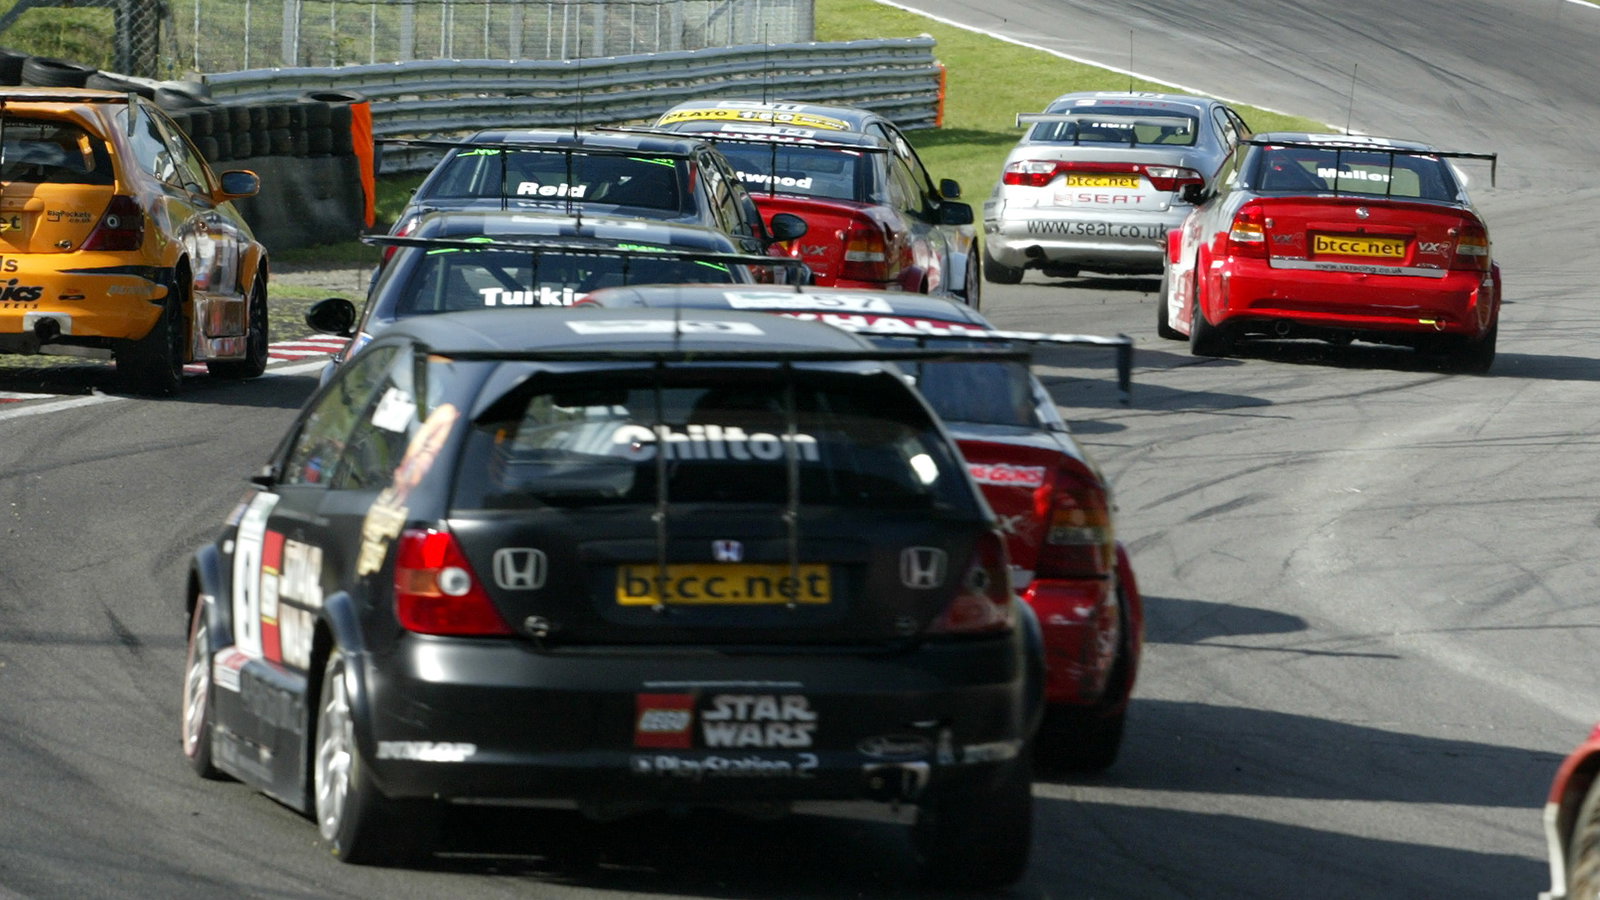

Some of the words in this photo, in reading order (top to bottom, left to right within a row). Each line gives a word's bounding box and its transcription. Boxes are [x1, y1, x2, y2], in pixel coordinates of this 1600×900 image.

[667, 110, 728, 121] PLATO
[1066, 174, 1139, 187] btcc.net
[1317, 167, 1394, 183] Muller
[516, 182, 587, 198] Reid
[1077, 193, 1146, 204] SEAT
[1027, 220, 1168, 239] www.seat.co.uk
[1316, 236, 1403, 256] btcc.net
[612, 424, 821, 462] Chilton
[624, 566, 826, 599] btcc.net
[702, 694, 818, 721] STAR
[702, 721, 818, 747] WARS
